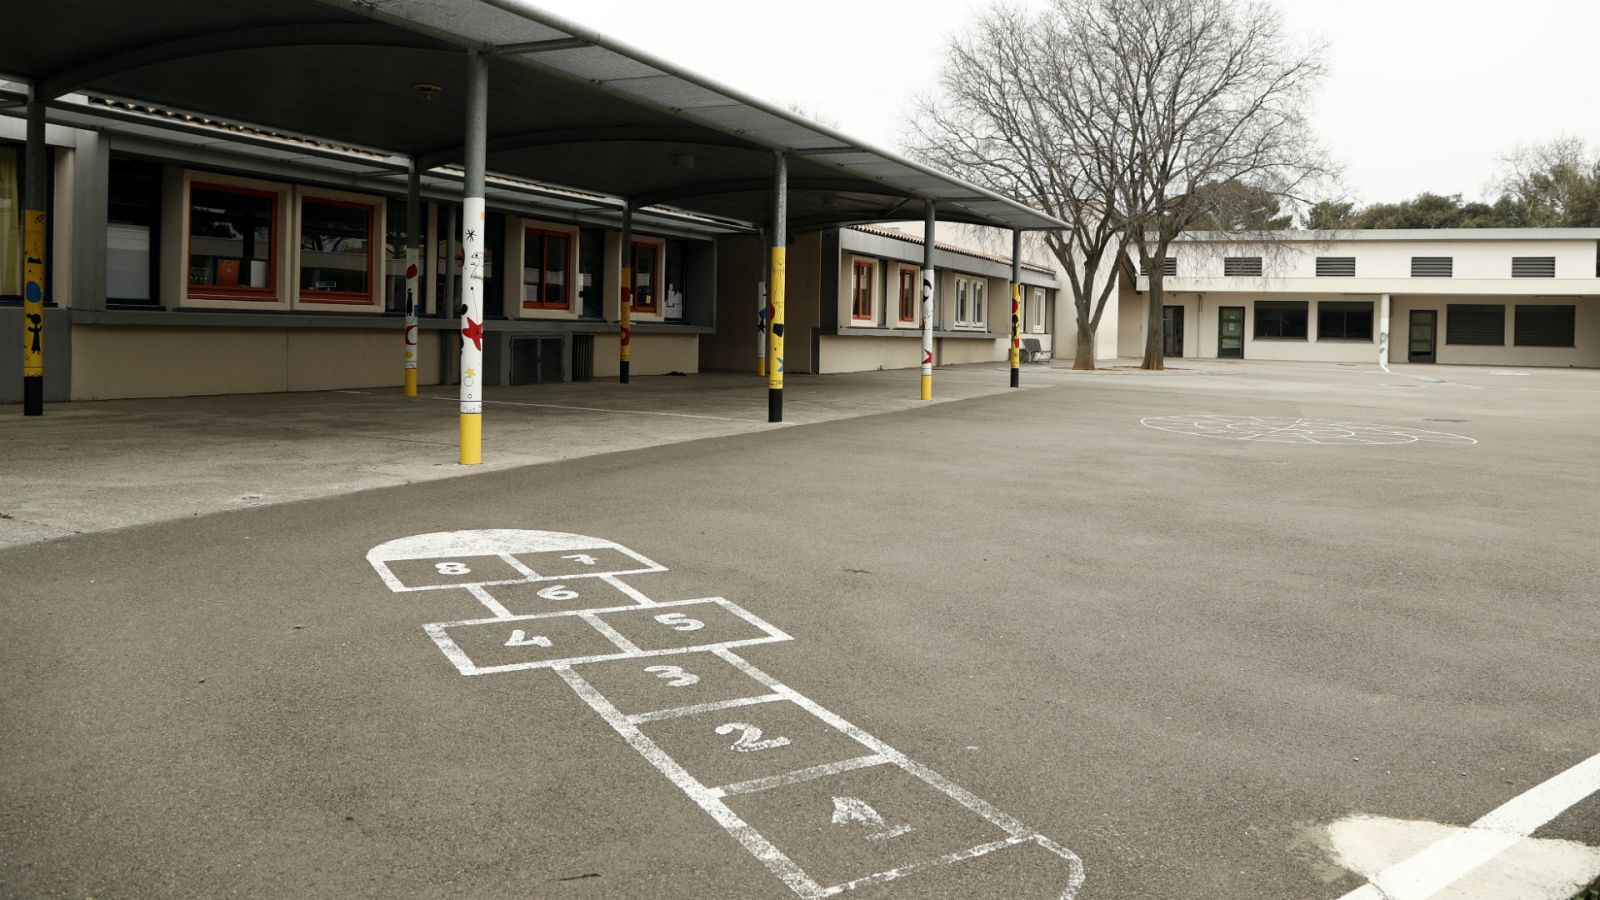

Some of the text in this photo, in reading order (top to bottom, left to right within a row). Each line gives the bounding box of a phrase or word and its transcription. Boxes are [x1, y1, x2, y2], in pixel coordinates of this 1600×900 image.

[561, 553, 598, 565] 7
[435, 562, 471, 575] 8
[537, 585, 579, 600] 6
[654, 612, 705, 631] 5
[504, 629, 553, 647] 4
[644, 665, 700, 687] 3
[715, 722, 791, 752] 2
[831, 796, 914, 840] 1
